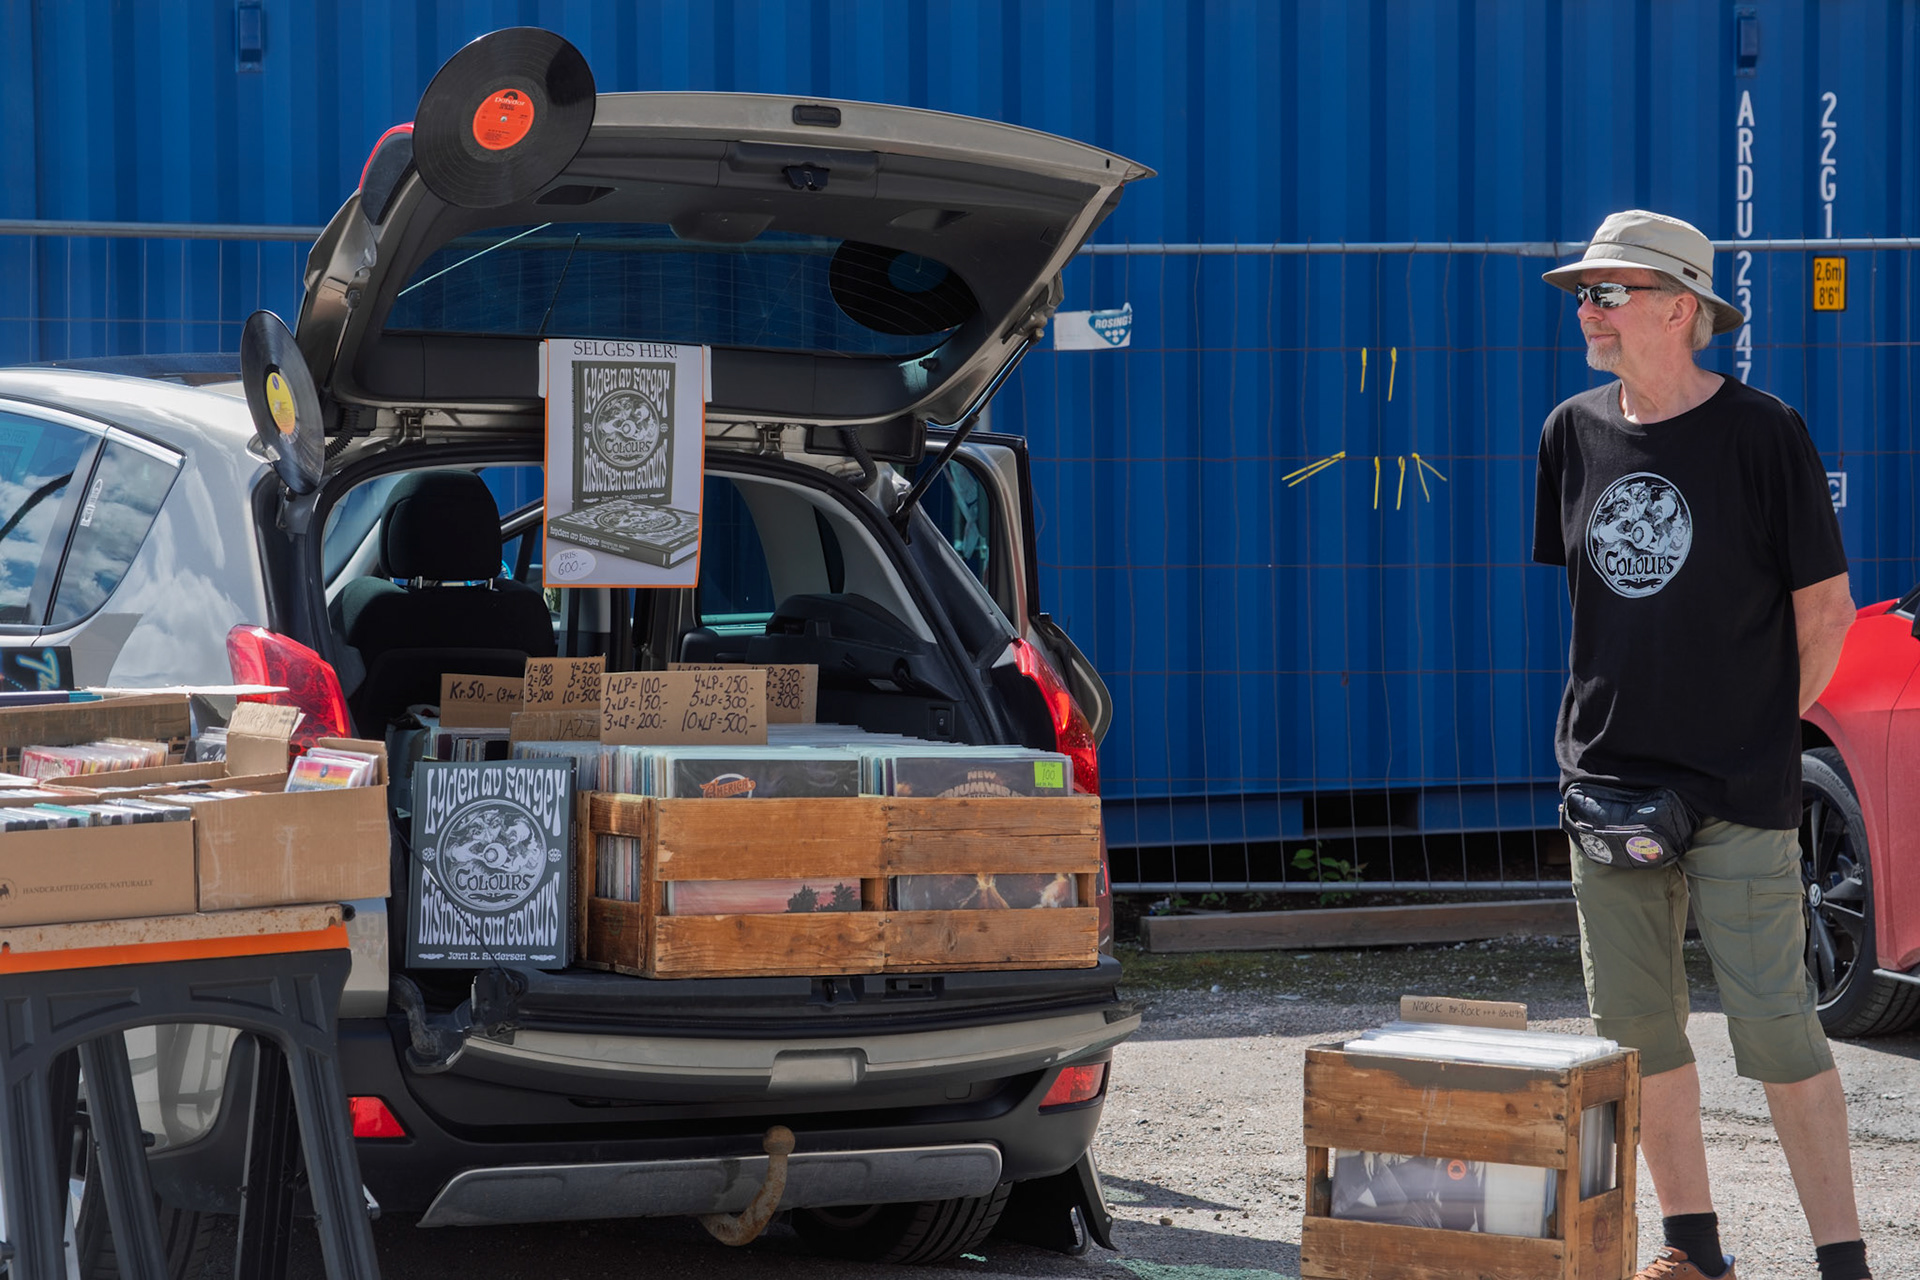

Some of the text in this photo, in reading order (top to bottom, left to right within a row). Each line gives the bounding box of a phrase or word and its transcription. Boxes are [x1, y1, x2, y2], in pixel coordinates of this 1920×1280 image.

[495, 97, 526, 106] Polydor
[1736, 90, 1755, 239] ARDU
[1819, 91, 1838, 239] 22G1
[573, 340, 678, 359] SELGES HER!
[559, 552, 577, 561] PRIS:
[550, 718, 600, 741] JAZZ
[481, 768, 502, 797] av
[967, 770, 997, 780] NEW
[1042, 768, 1056, 781] 100
[22, 884, 80, 895] HANDCRAFTED
[110, 879, 154, 889] NATURALLY
[482, 916, 505, 946] om
[447, 951, 469, 960] Jørn
[470, 952, 480, 960] R.
[1412, 1000, 1443, 1014] NORSK
